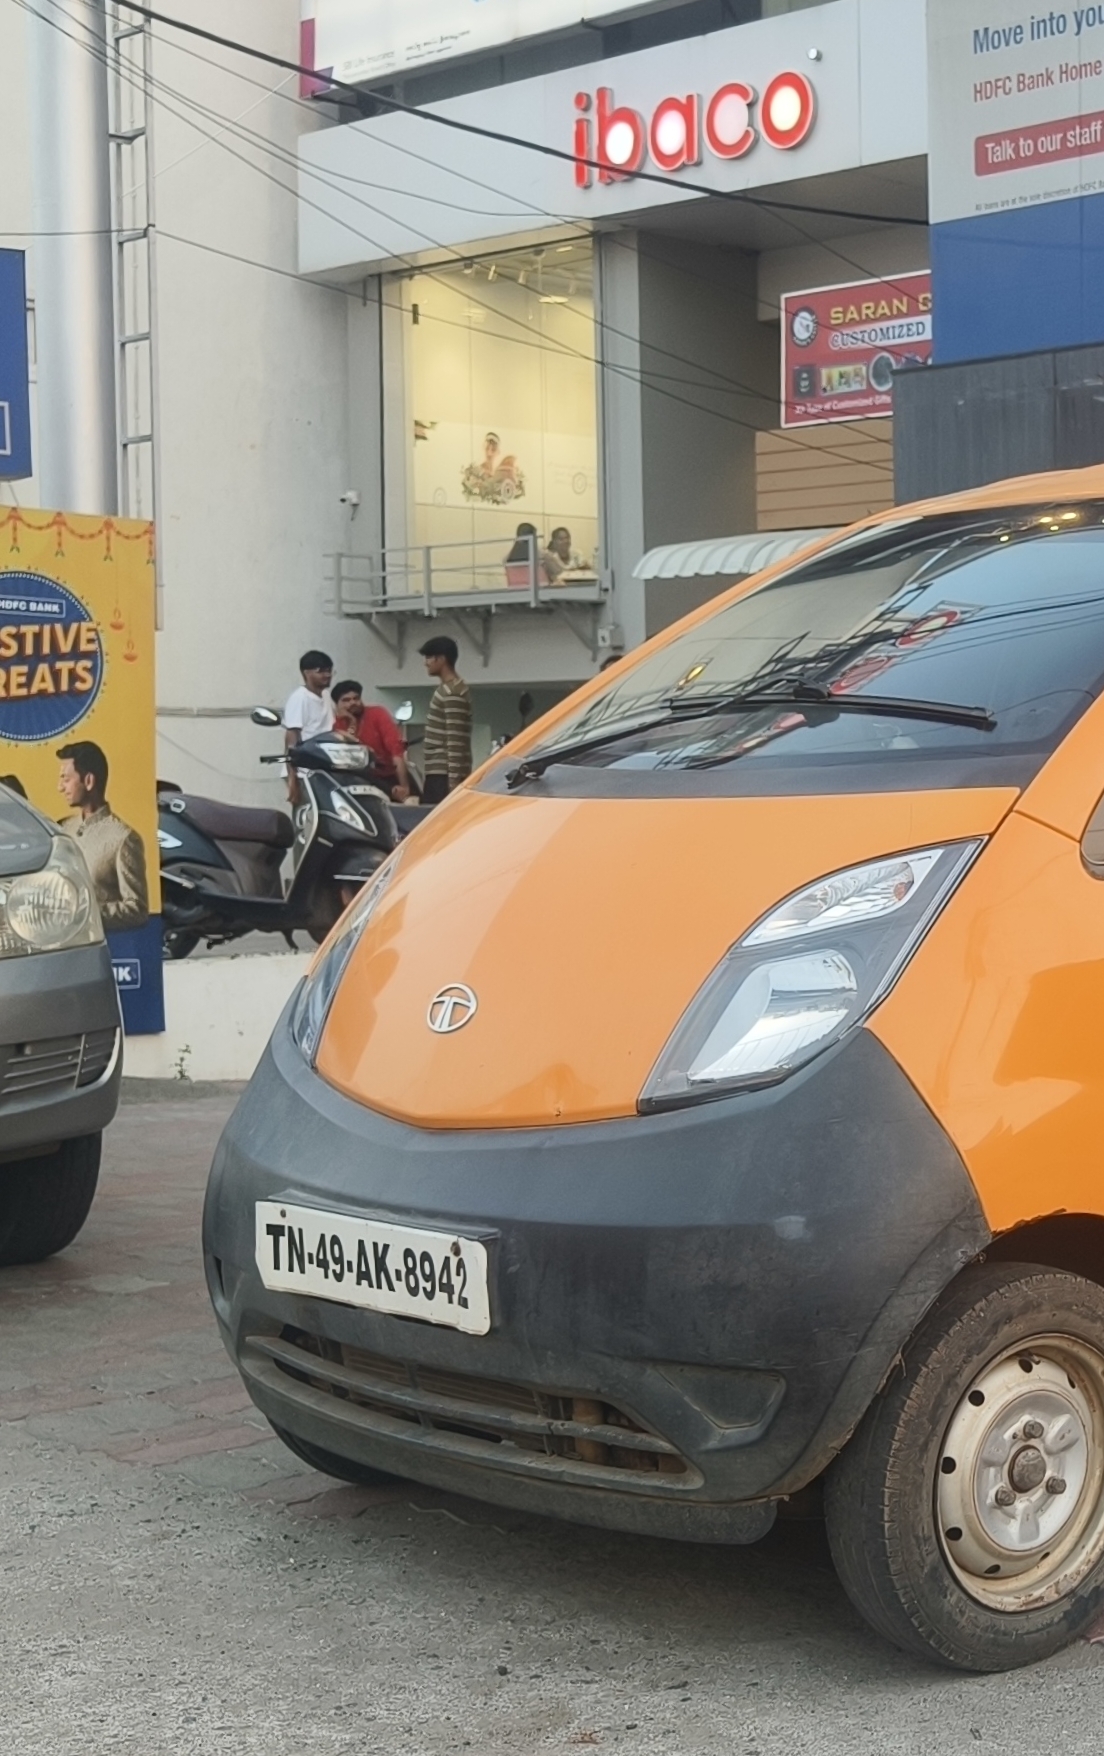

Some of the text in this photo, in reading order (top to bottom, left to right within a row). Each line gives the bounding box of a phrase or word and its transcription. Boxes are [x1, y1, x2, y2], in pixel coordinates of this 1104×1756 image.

[973, 25, 1024, 55] Move
[1030, 11, 1067, 42] into
[973, 74, 1012, 102] HDFC
[1016, 66, 1055, 92] Bank
[1059, 57, 1102, 84] Home
[573, 71, 817, 189] ibaco
[984, 139, 1016, 165] Talk
[1018, 134, 1034, 157] to
[1038, 130, 1064, 153] our
[1066, 121, 1102, 148] staff
[830, 296, 908, 325] SARAN
[830, 321, 926, 349] CUSTOMIZED
[29, 601, 60, 614] BANK
[265, 1223, 470, 1310] TN-49-AK-8942
